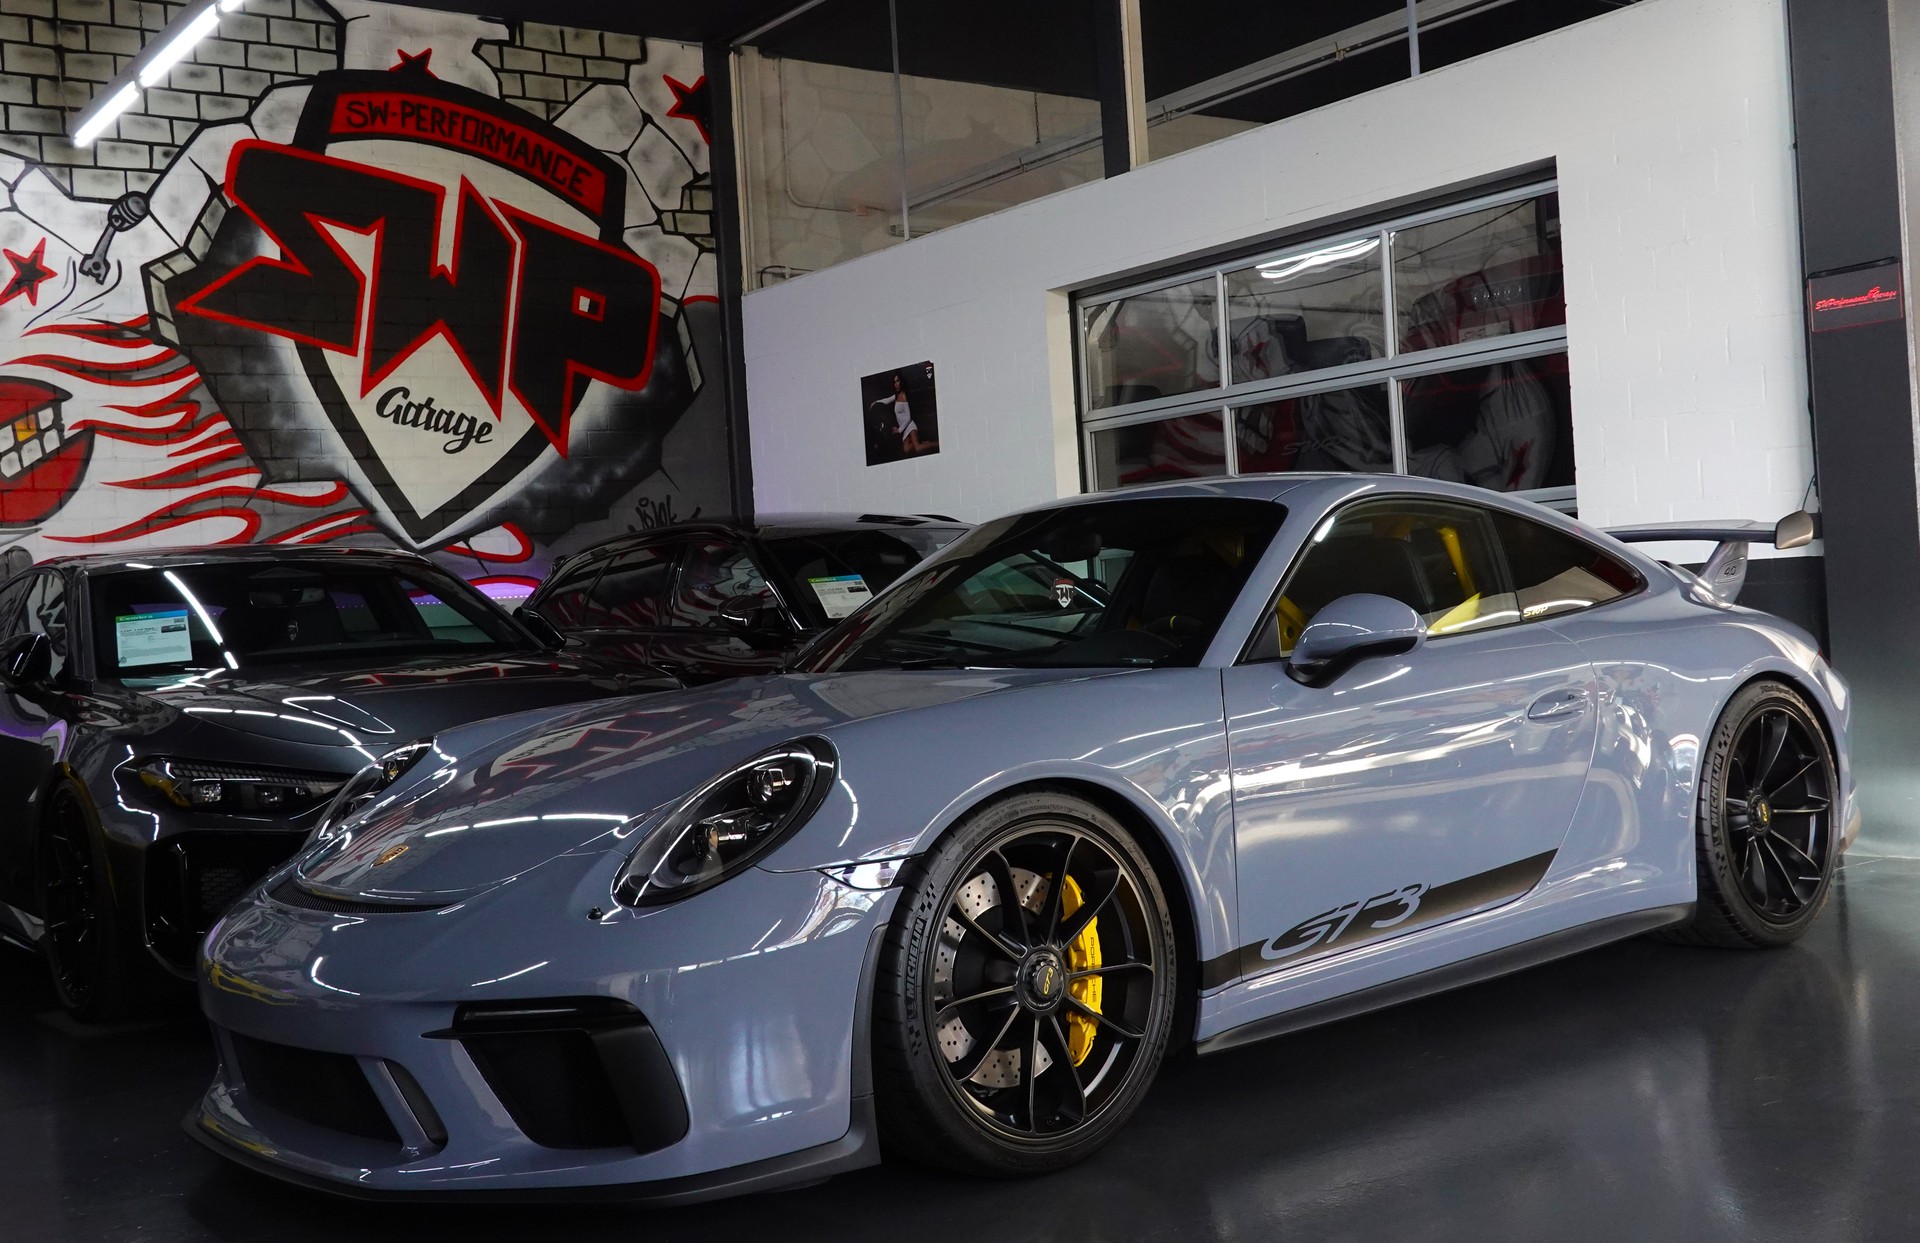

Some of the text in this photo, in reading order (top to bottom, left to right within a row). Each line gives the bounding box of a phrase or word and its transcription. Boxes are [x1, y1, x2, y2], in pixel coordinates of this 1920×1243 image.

[346, 101, 592, 197] SW-PERFORMANCE
[177, 139, 662, 459] SWP
[375, 386, 493, 454] Garage
[1710, 754, 1724, 827] MICHELIN
[906, 916, 926, 999] MICHELIN
[1260, 883, 1431, 960] GT3
